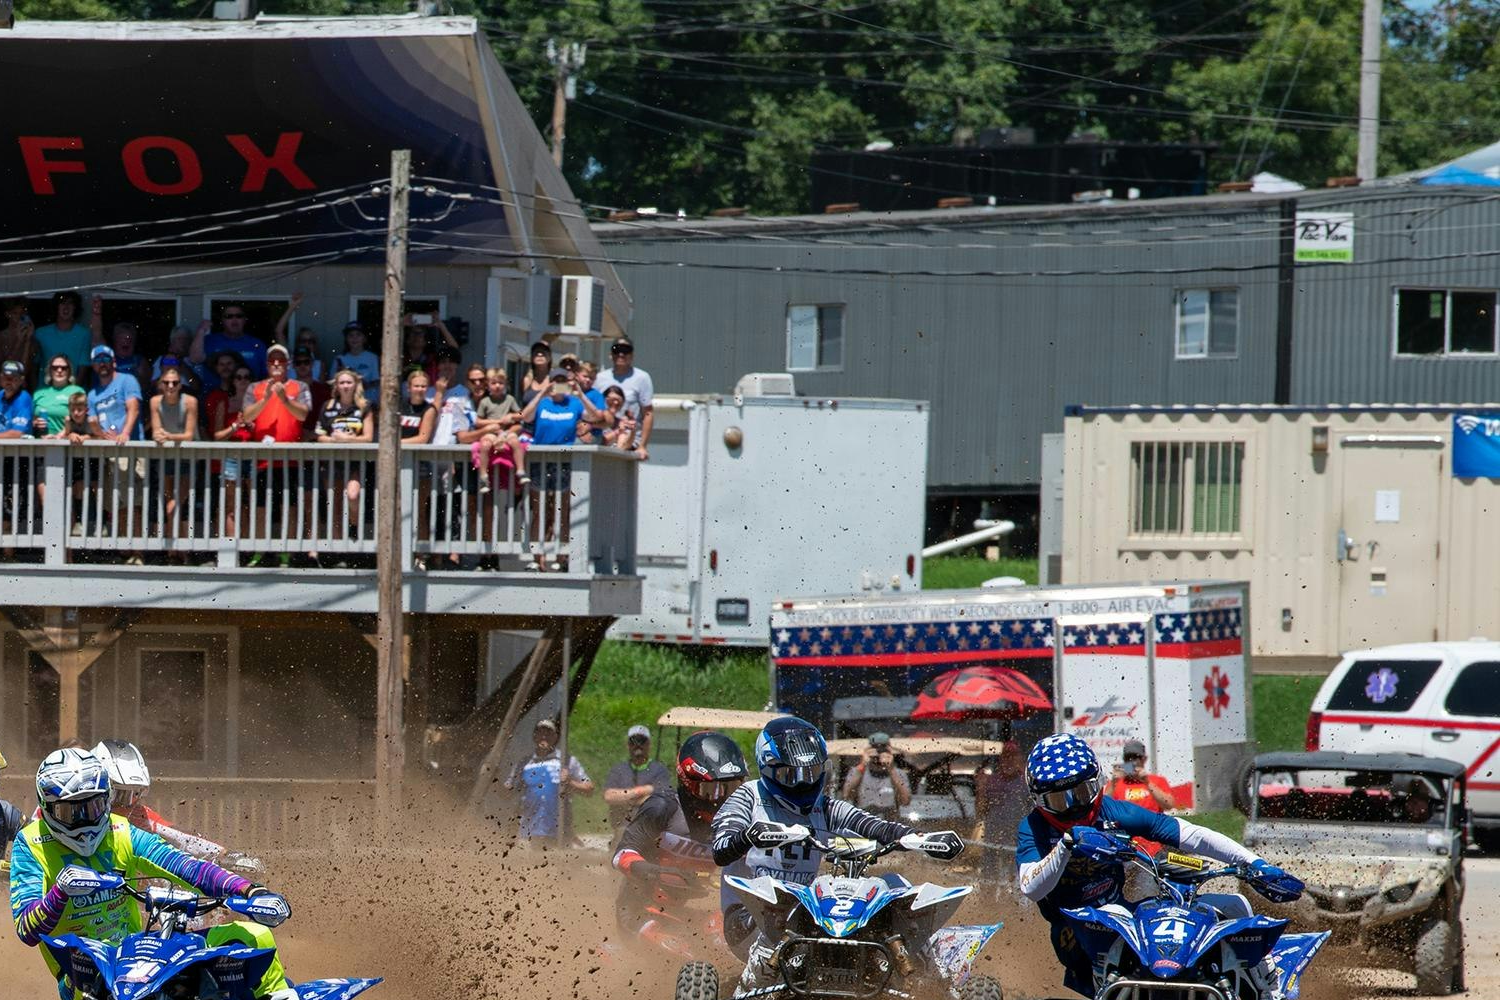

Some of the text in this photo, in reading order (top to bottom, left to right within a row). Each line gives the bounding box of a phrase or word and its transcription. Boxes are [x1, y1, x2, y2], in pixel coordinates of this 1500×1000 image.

[19, 132, 317, 196] FOX
[1108, 600, 1132, 613] AIR
[1136, 598, 1173, 613] EVAC
[829, 900, 855, 915] 2
[1153, 921, 1188, 940] 4
[1230, 935, 1262, 943] MAXXIS
